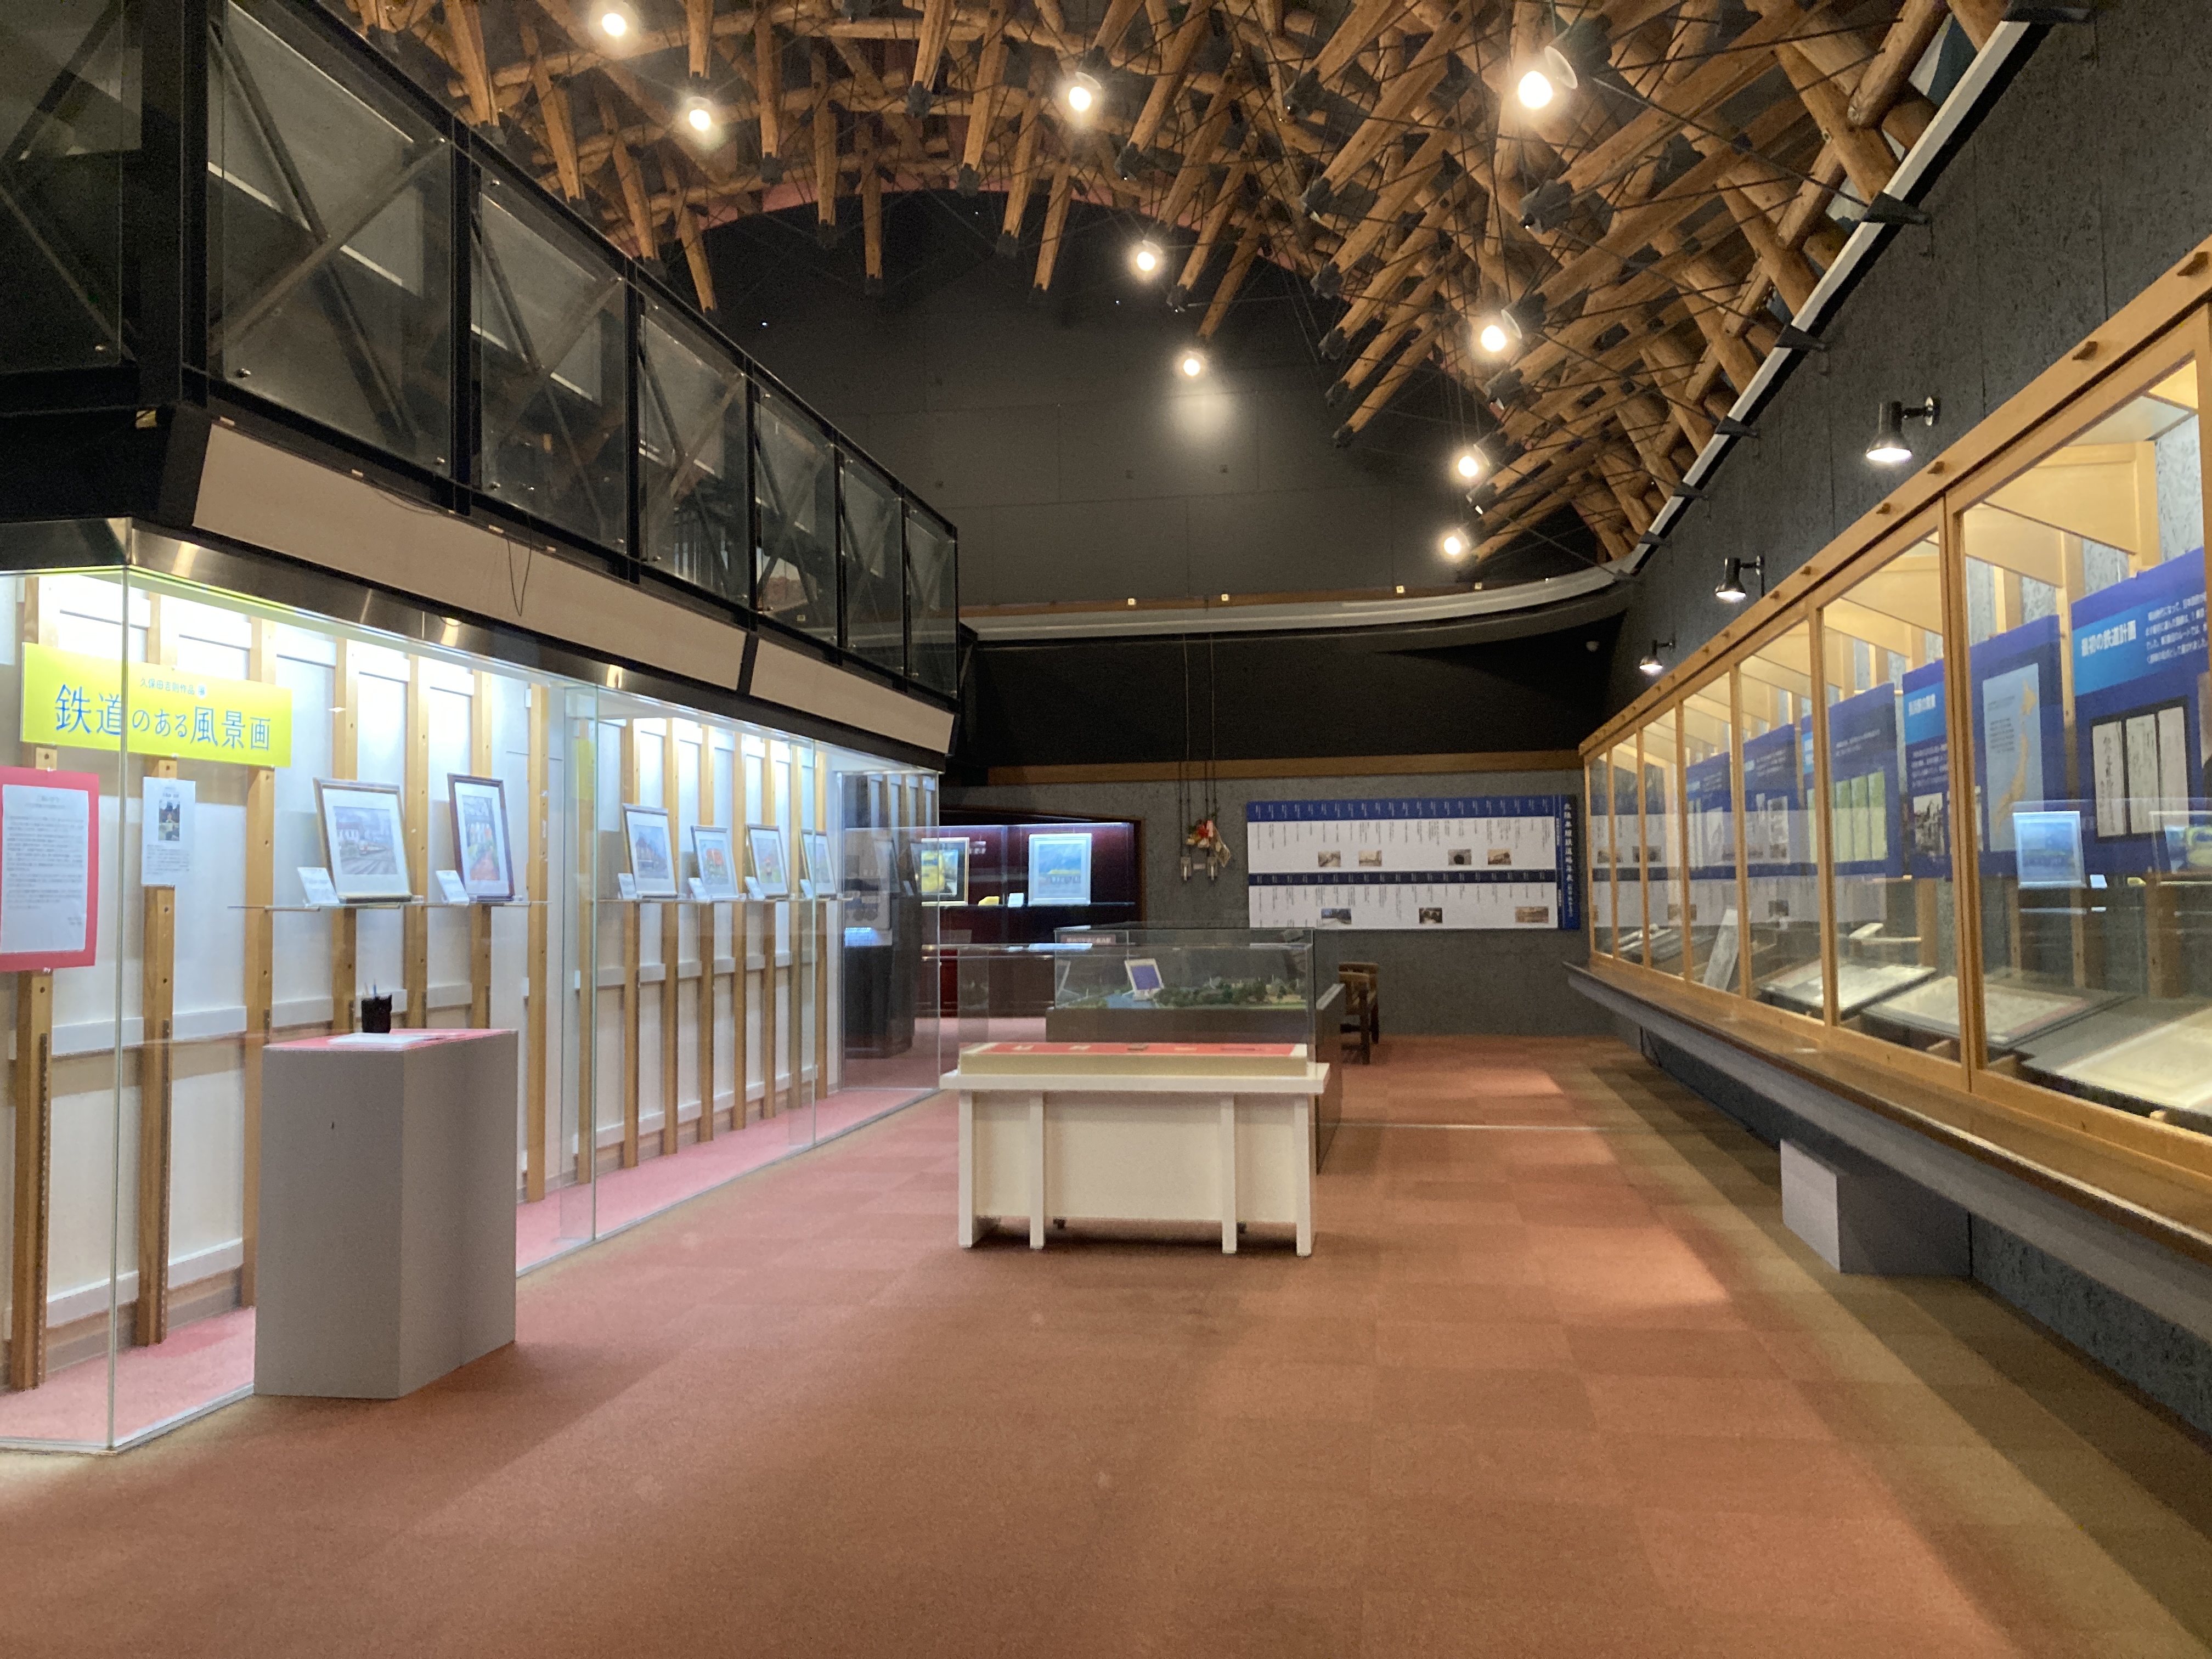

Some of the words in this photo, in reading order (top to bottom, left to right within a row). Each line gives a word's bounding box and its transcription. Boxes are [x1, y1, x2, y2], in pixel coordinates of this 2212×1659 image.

[55, 684, 271, 751] 鉄道のある風景画
